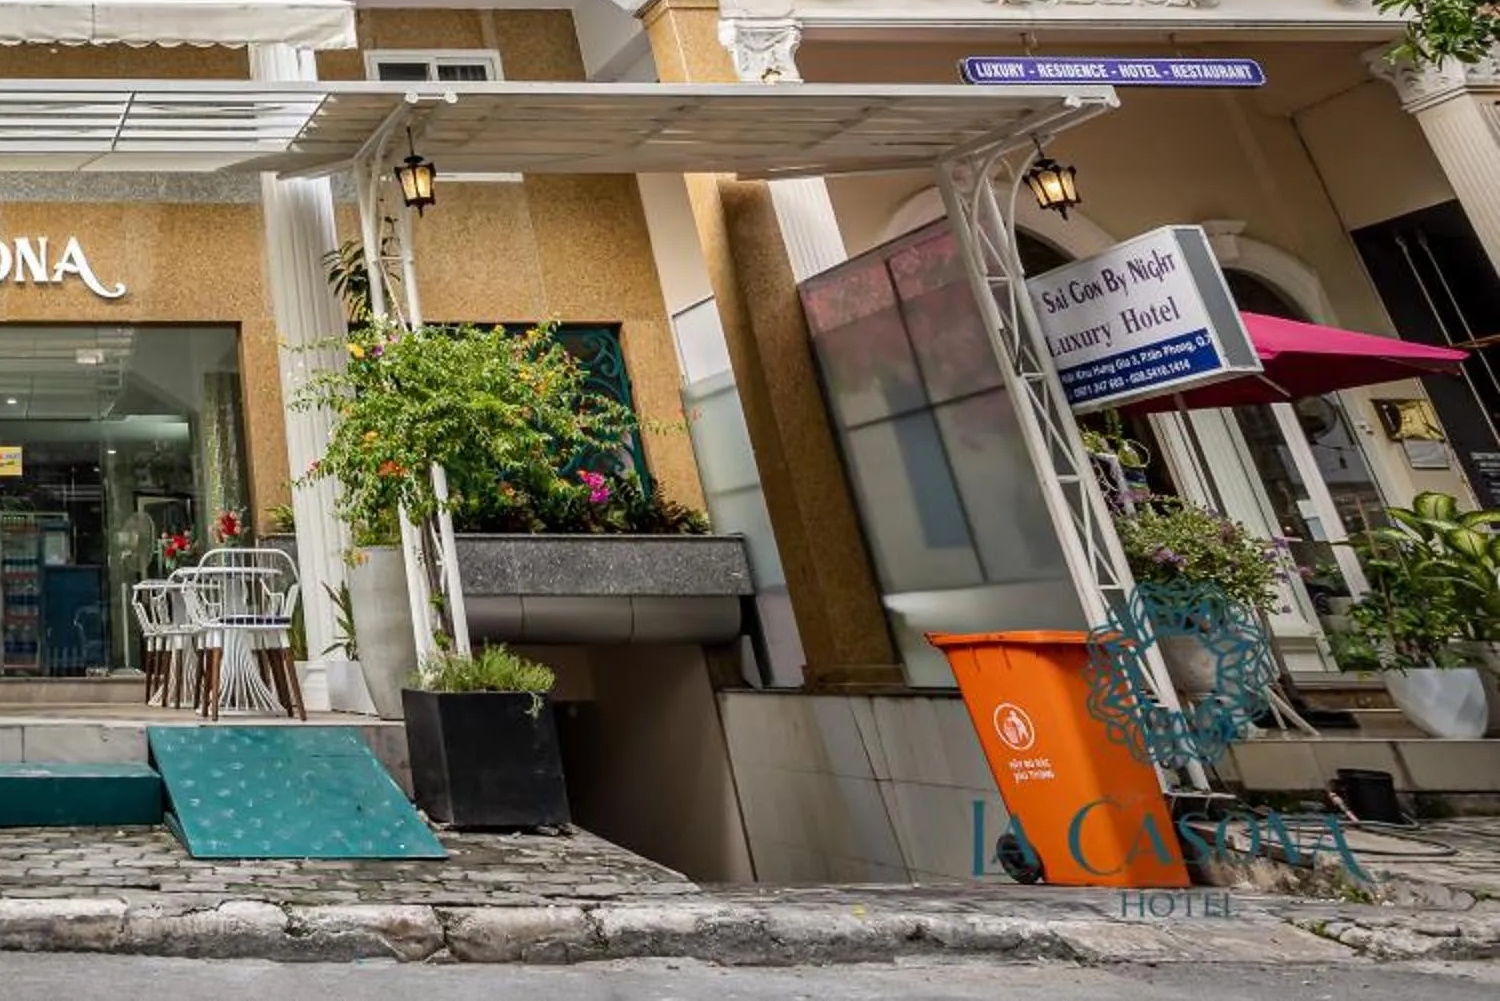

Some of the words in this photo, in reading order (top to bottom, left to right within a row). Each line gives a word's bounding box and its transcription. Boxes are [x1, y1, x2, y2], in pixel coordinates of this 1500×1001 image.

[975, 62, 1026, 78] LUXURY
[1038, 63, 1109, 79] RESIDENCE
[1119, 63, 1162, 79] HOTEL
[1172, 63, 1253, 80] RESTAURANT
[1045, 322, 1112, 358] Luxury
[1120, 295, 1181, 335] Hotel
